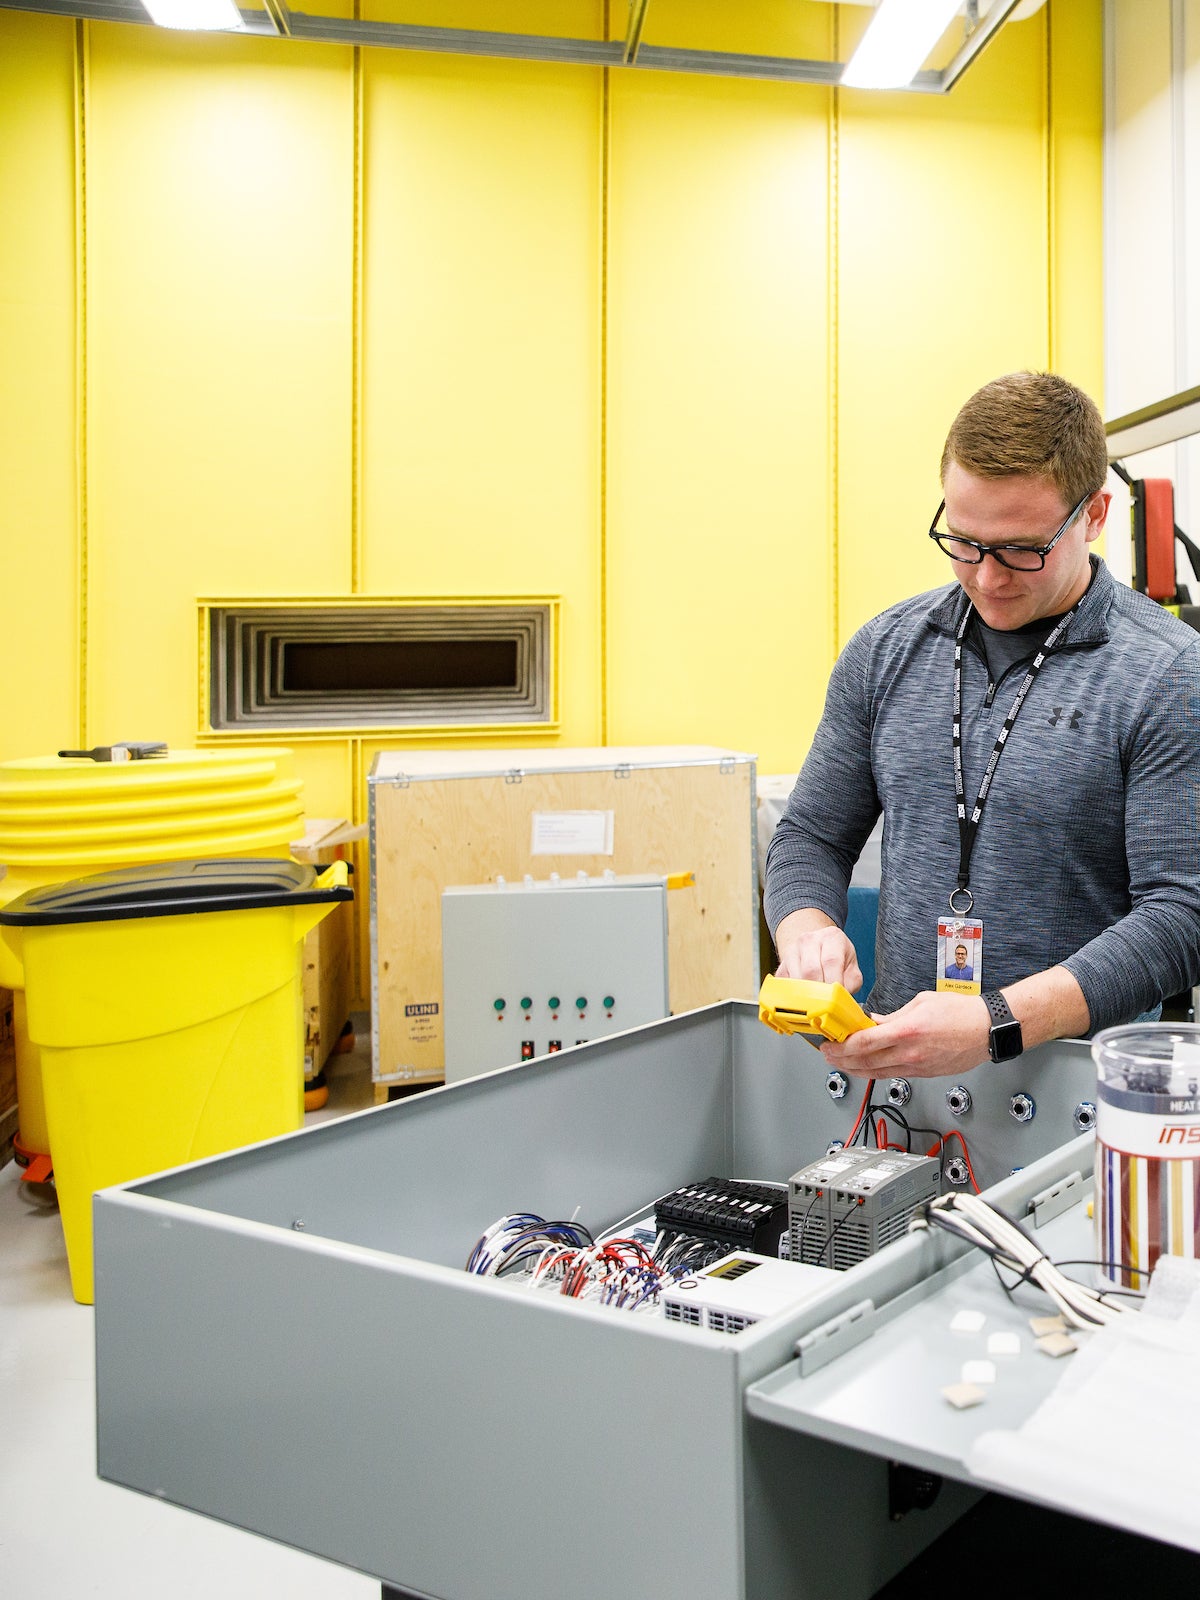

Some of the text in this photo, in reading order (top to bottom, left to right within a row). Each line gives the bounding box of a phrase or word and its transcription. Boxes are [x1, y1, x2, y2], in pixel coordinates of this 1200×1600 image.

[1033, 652, 1045, 669] ASU
[997, 726, 1010, 744] ASU
[957, 804, 966, 819] ASU
[971, 805, 982, 824] ASU
[407, 1004, 436, 1015] ULINE
[1170, 1100, 1196, 1112] HEAT
